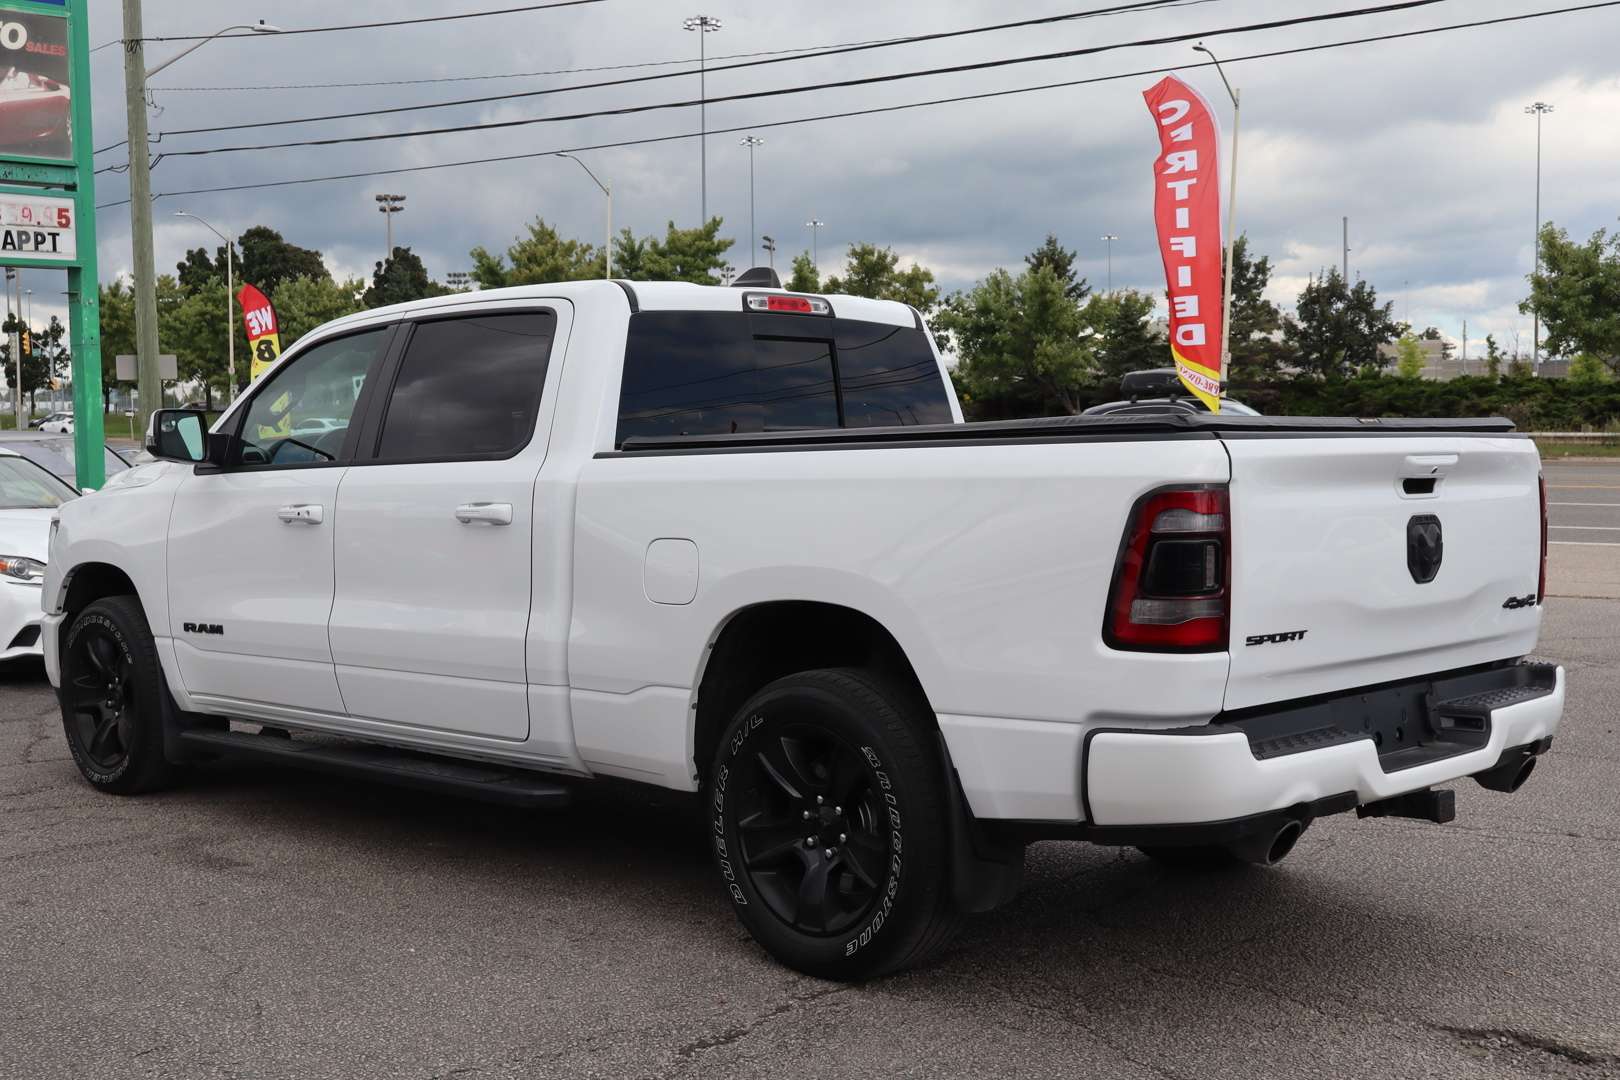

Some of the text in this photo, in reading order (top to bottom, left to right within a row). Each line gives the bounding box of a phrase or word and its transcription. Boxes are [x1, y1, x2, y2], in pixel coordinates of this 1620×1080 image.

[0, 21, 66, 56] O SALES
[1, 229, 60, 253] APPT
[183, 622, 224, 635] RAM
[1245, 630, 1308, 646] SPORT
[713, 713, 764, 905] DUELER H/L
[846, 745, 902, 957] BRIDGESTONE
